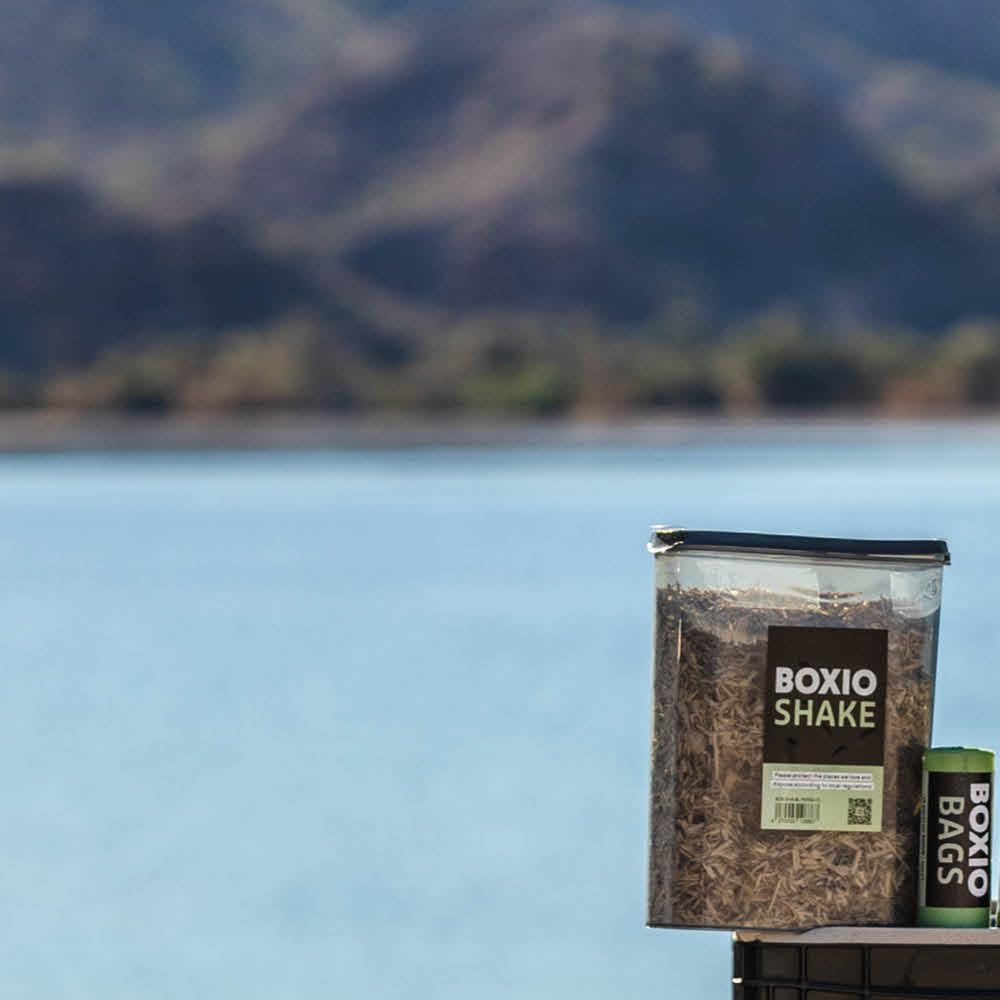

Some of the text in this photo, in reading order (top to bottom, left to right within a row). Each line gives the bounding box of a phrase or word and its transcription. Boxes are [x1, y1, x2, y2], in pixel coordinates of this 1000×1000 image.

[775, 666, 877, 696] BOXIO
[774, 698, 876, 728] SHAKE
[937, 796, 965, 885] BAGS
[967, 783, 990, 897] BOXIO
